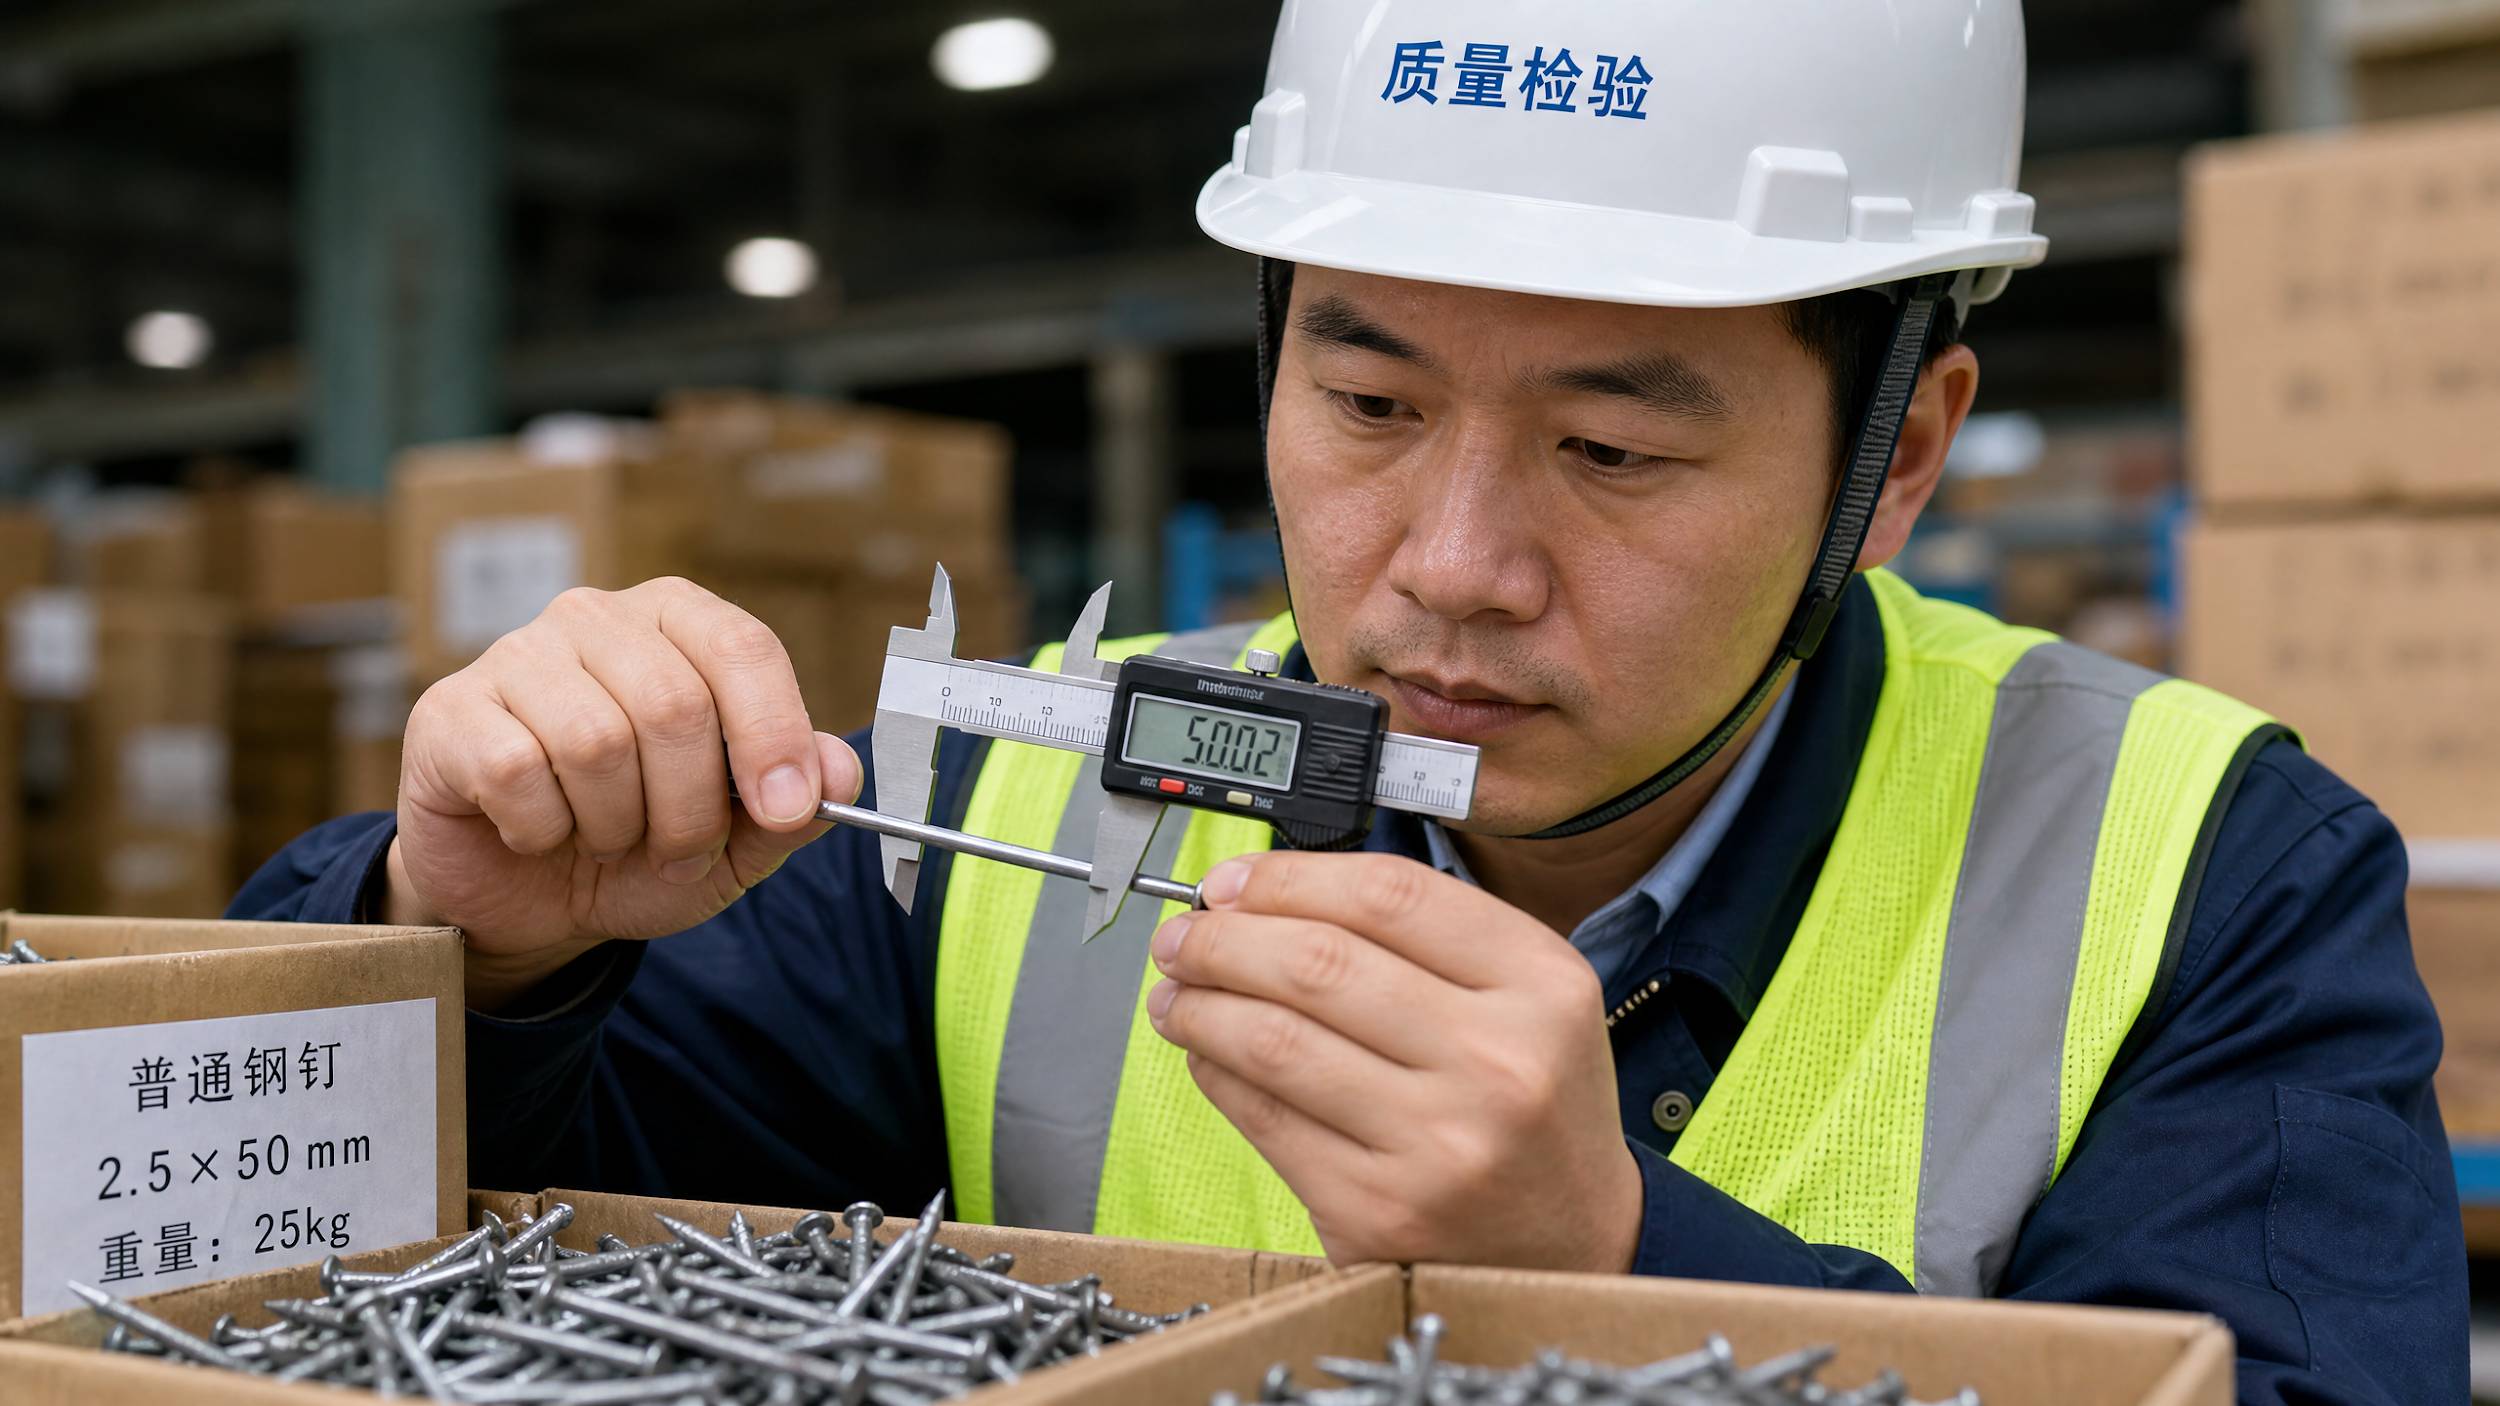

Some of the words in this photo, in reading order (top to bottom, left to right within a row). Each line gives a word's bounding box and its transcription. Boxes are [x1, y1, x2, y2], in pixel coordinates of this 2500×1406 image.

[1380, 40, 1654, 120] 质量检验
[128, 1040, 341, 1112] 普通钢钉
[98, 1149, 172, 1201] 2.5
[237, 1134, 290, 1180] 50
[307, 1134, 371, 1169] mm
[254, 1206, 351, 1255] 25kg
